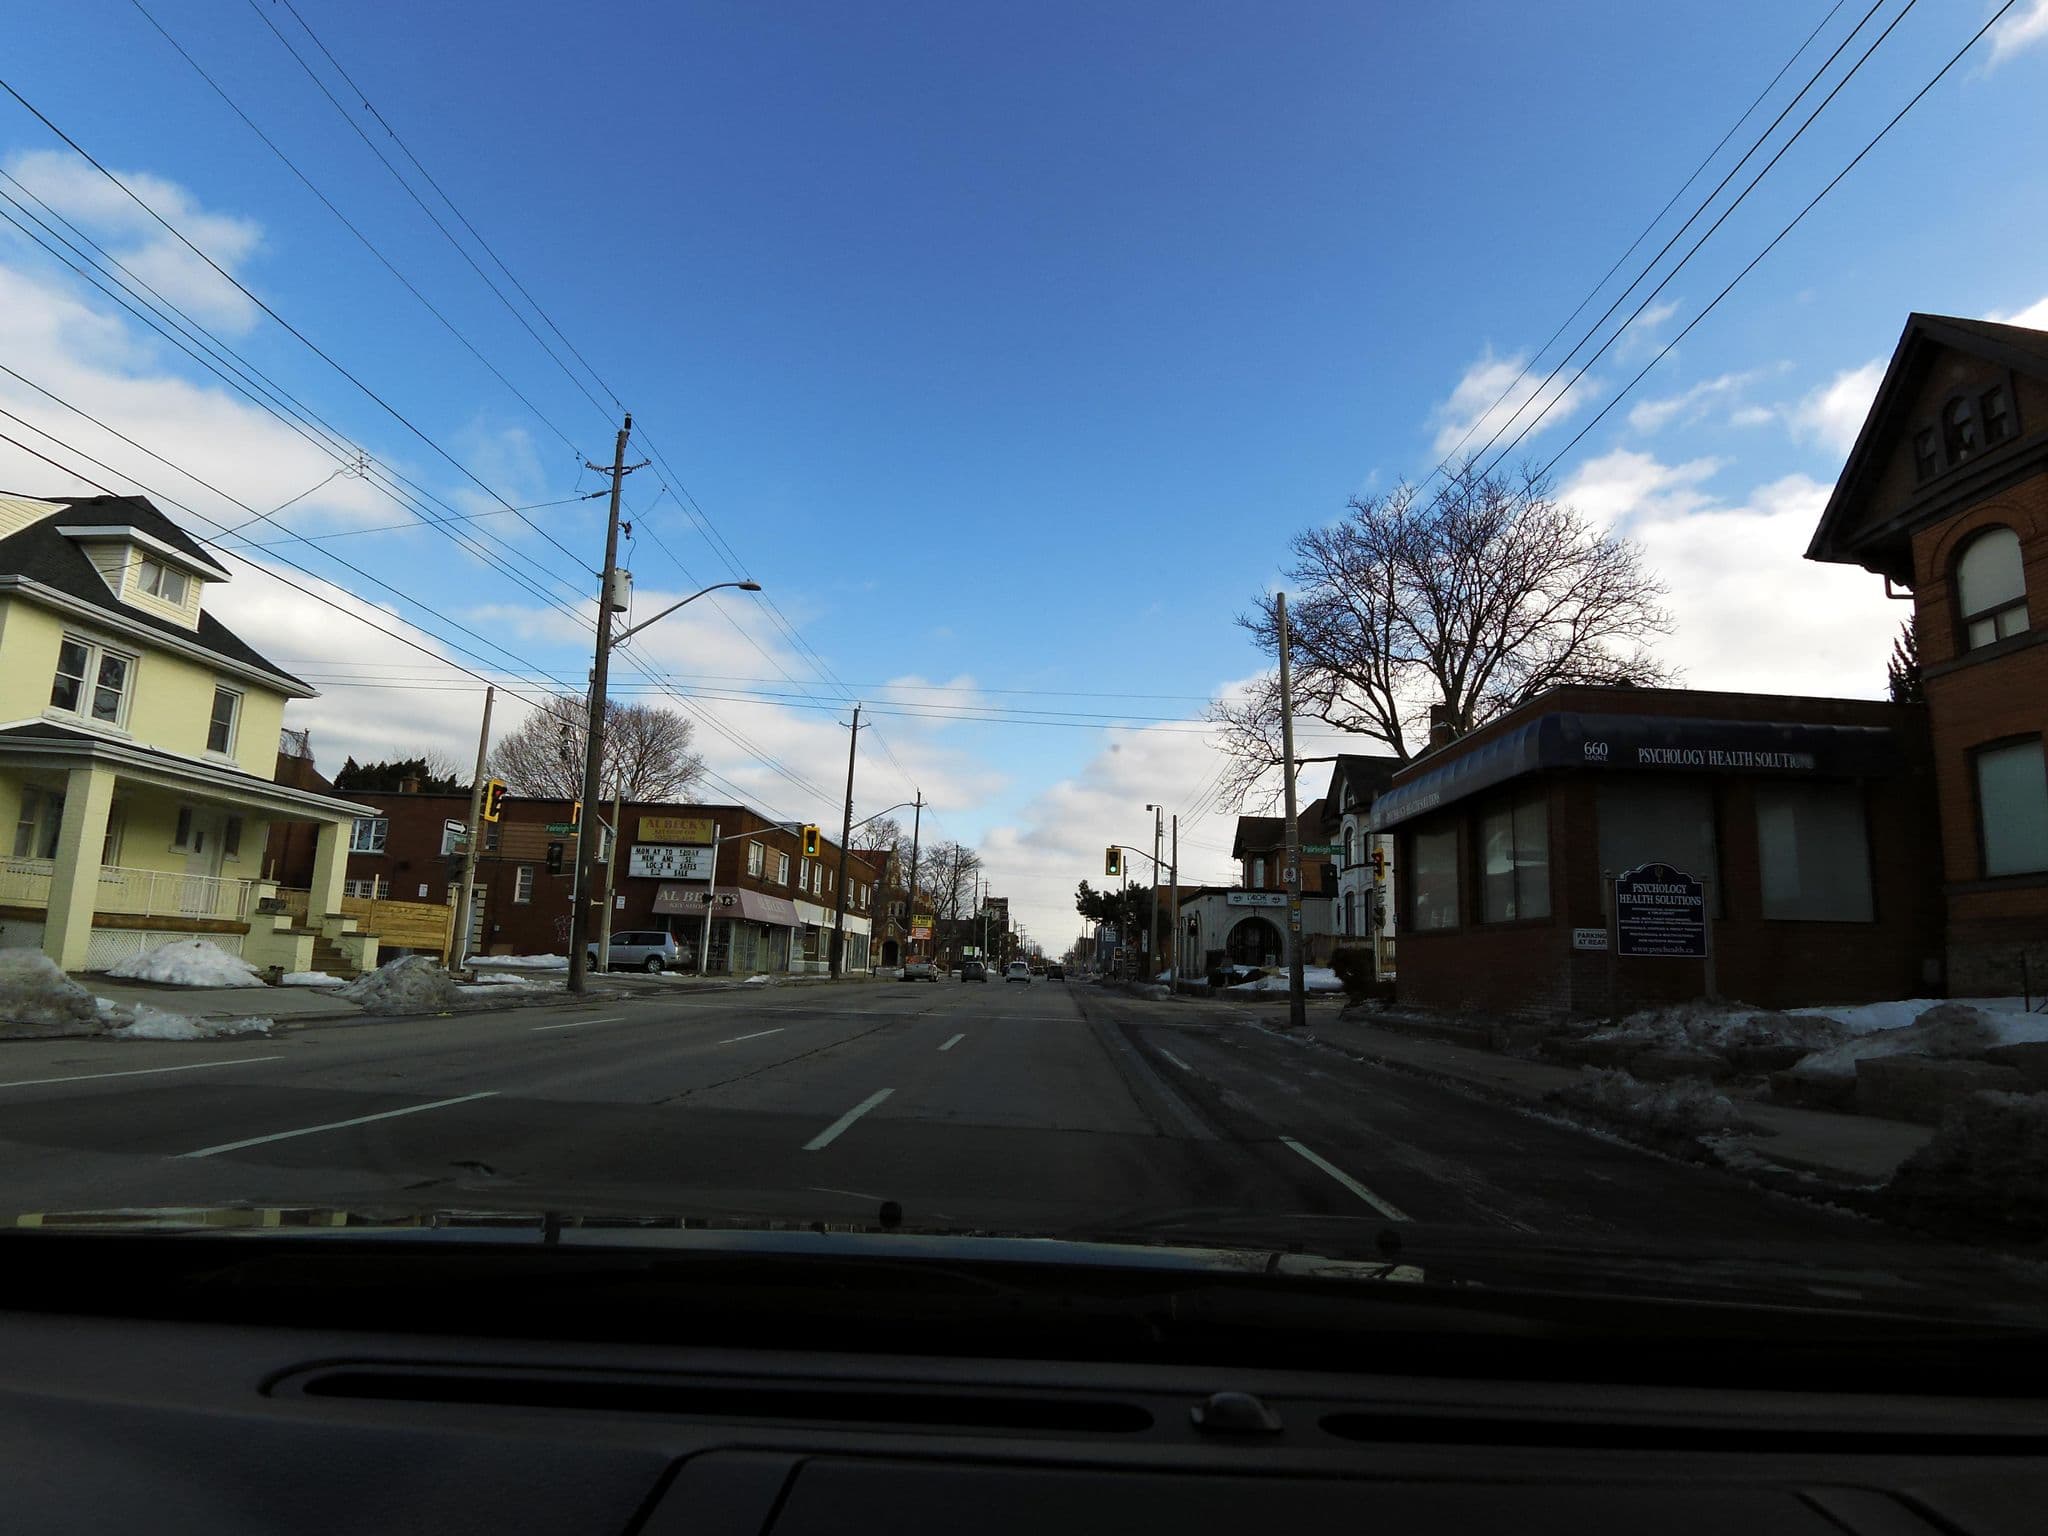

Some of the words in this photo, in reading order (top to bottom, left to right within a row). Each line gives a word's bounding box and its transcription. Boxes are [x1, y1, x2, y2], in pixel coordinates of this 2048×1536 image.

[1584, 741, 1608, 755] 660
[1638, 747, 1706, 765] PSYCHOLOGY
[1709, 750, 1753, 766] HEALTH
[1754, 752, 1816, 769] SOLUTIO
[1633, 883, 1687, 894] PSYCHOLOGY
[659, 890, 679, 902] AL
[1620, 894, 1653, 905] HEALTH
[1655, 896, 1702, 906] SOLUTIONS
